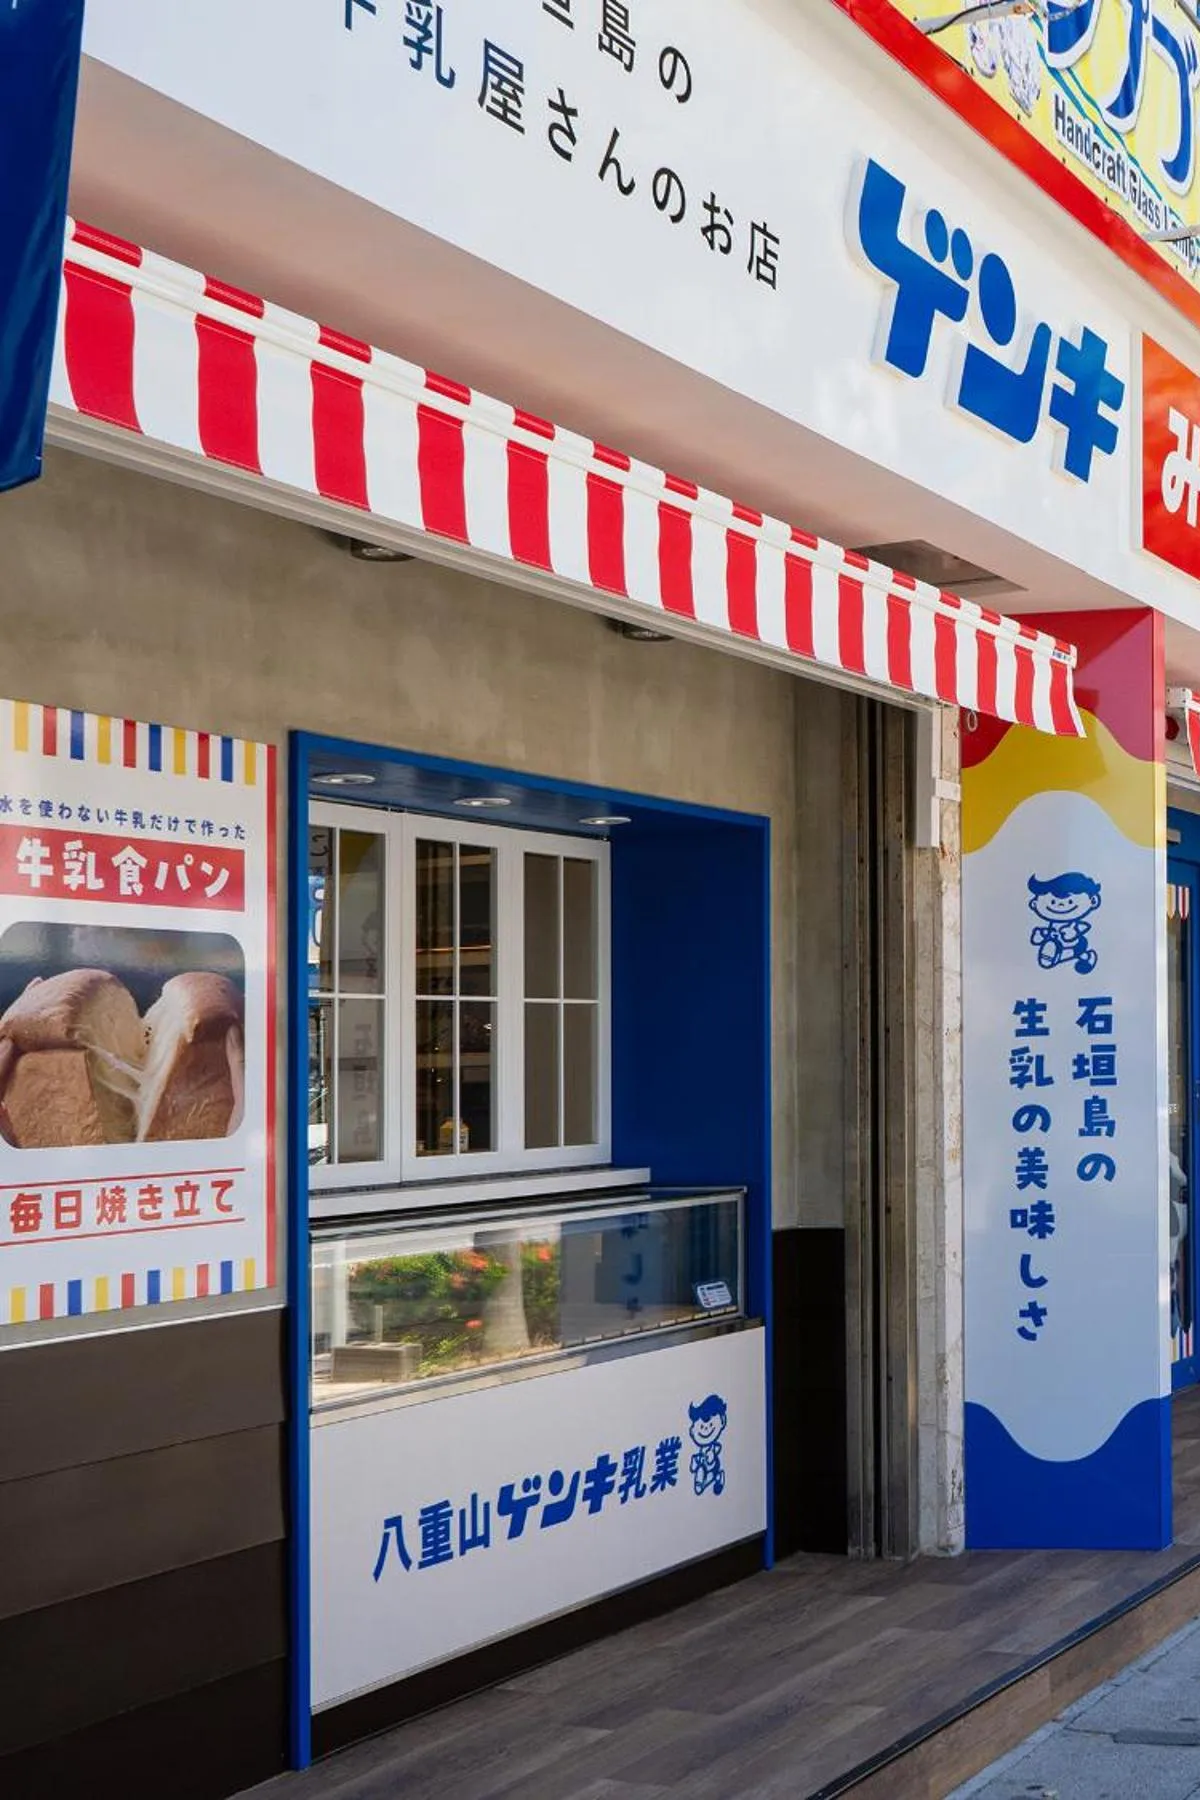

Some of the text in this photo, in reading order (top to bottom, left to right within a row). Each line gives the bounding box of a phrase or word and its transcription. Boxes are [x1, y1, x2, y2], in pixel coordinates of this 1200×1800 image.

[542, 0, 692, 103] 島の
[1055, 93, 1127, 194] Handcraft
[1129, 169, 1161, 230] Glass
[857, 157, 1125, 484] ゲンキ
[0, 795, 246, 841] 水を使わない牛乳だけで作った
[15, 836, 230, 898] 牛乳食パン
[1071, 996, 1118, 1184] 石垣島の
[10, 1178, 235, 1234] 毎日焼き立て
[1008, 997, 1056, 1343] 生乳の美味しさ
[372, 1435, 683, 1584] 八重山ゲンキ乳業
